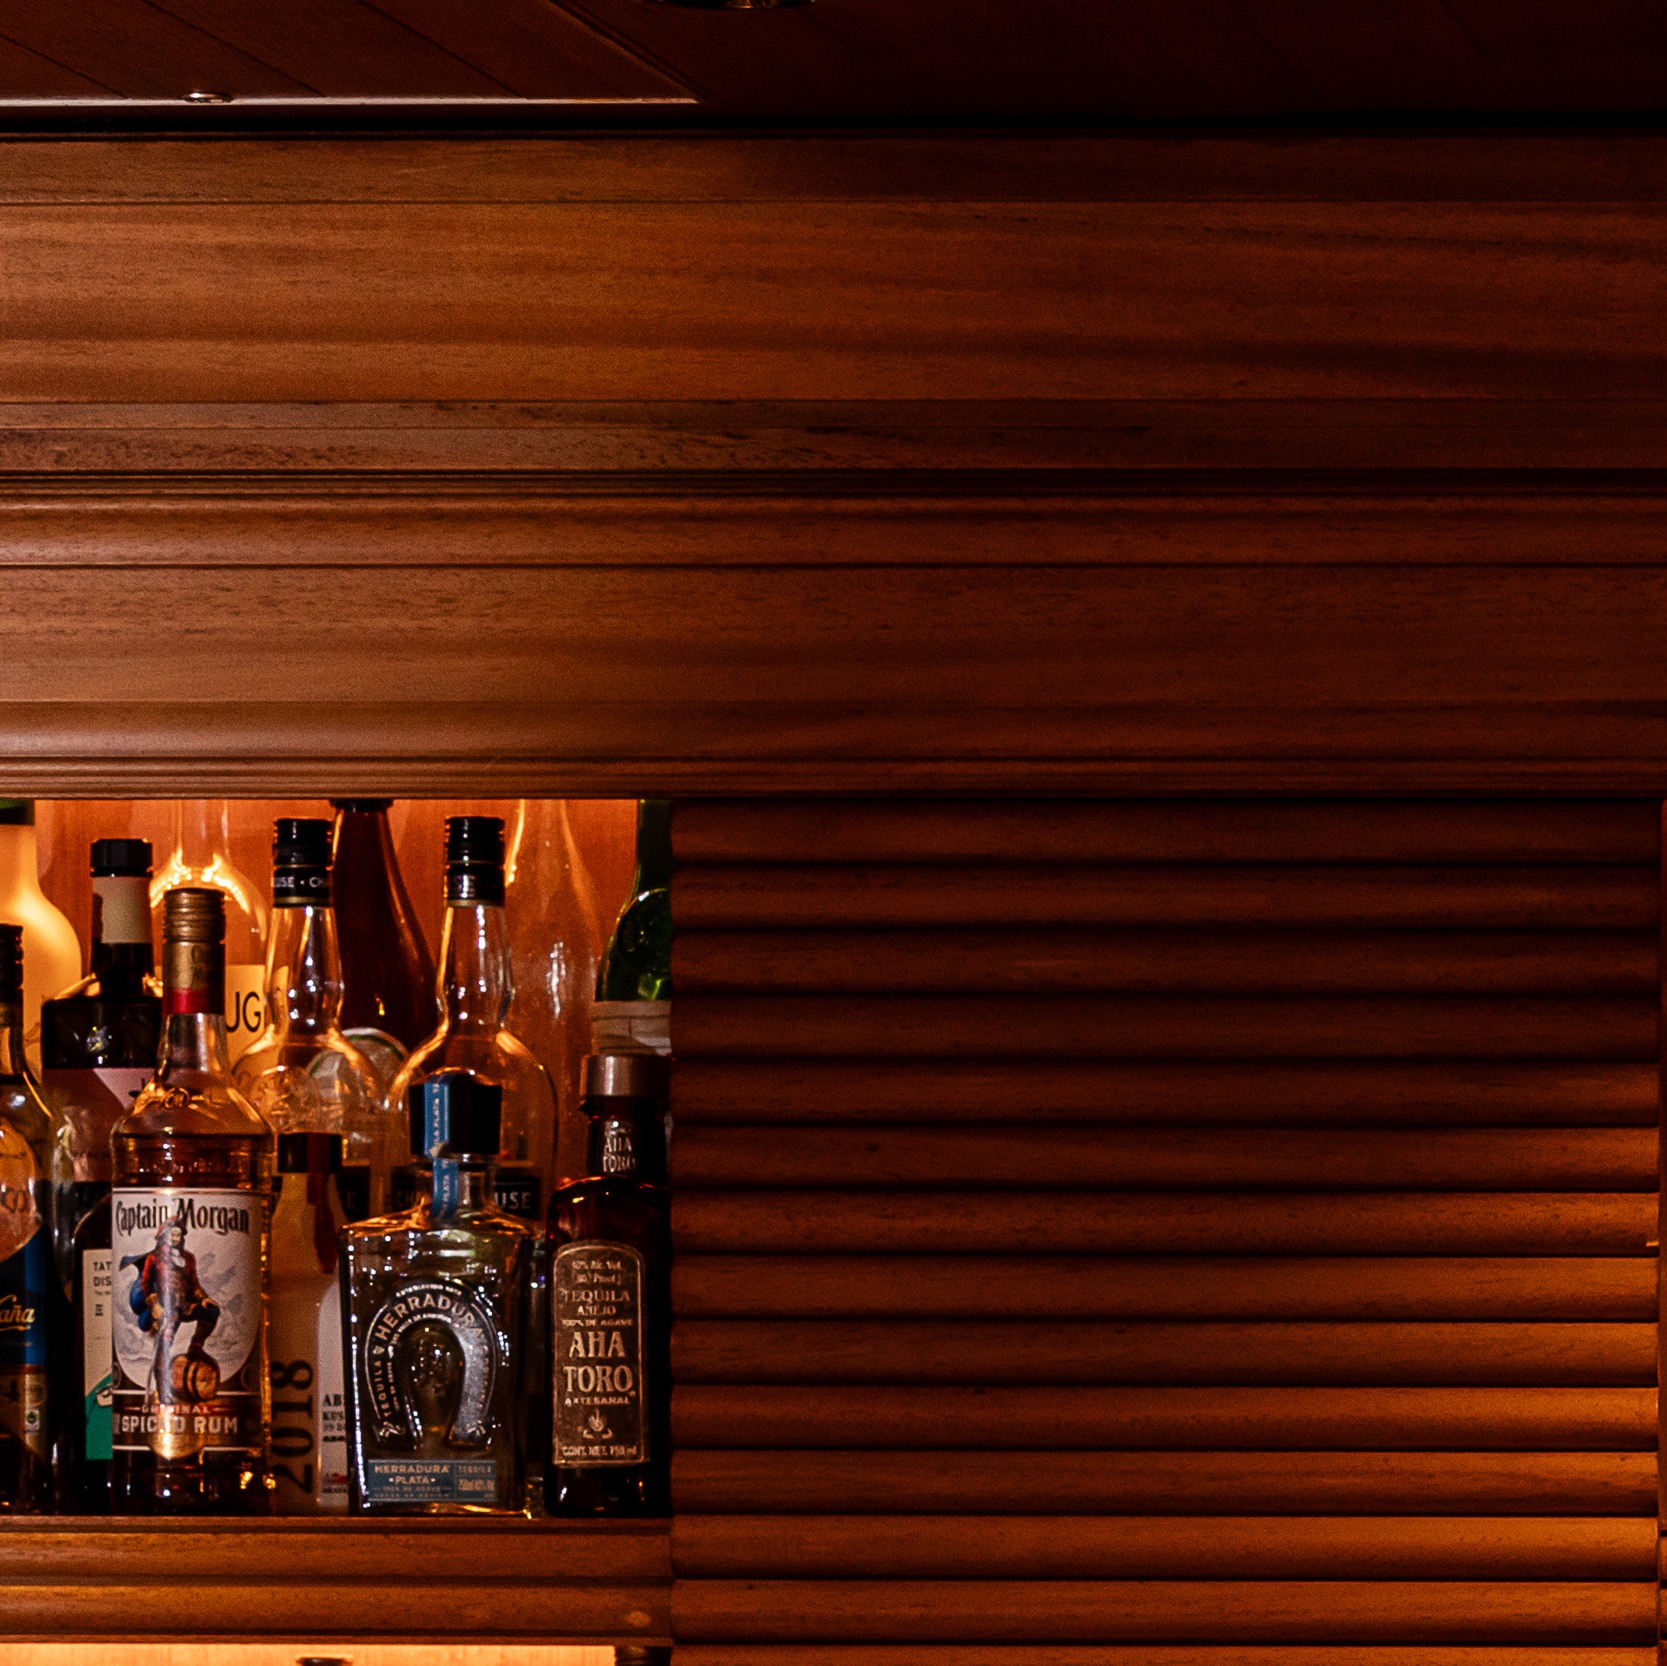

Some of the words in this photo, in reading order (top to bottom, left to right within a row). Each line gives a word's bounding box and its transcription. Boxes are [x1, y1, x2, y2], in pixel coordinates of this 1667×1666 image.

[116, 1201, 170, 1235] Captain
[172, 1197, 250, 1237] Morgan
[560, 1288, 631, 1304] TEQUILA
[375, 1292, 484, 1341] HERRADURA
[568, 1330, 626, 1358] AHA
[562, 1365, 633, 1393] TORO
[120, 1414, 186, 1435] SPICD
[193, 1414, 239, 1435] RUM
[271, 1360, 314, 1493] 2018
[373, 1464, 450, 1475] HERRADURA
[394, 1475, 430, 1485] PLATA
